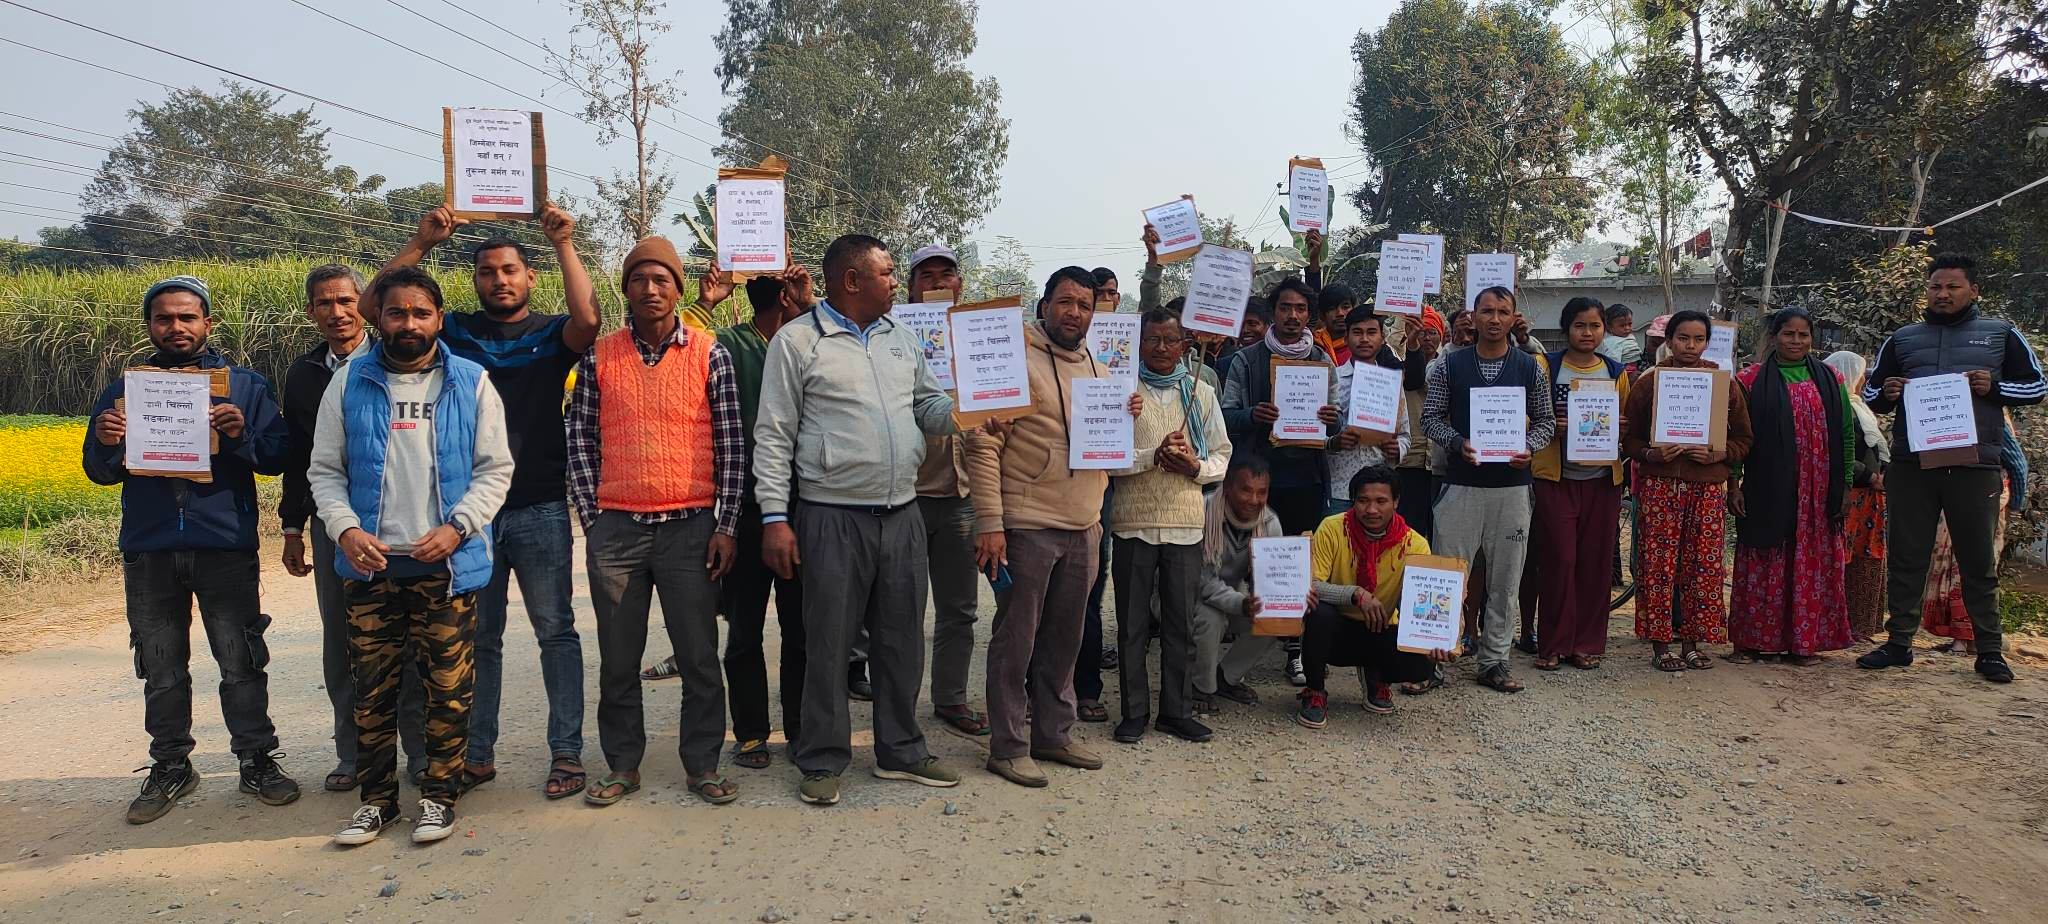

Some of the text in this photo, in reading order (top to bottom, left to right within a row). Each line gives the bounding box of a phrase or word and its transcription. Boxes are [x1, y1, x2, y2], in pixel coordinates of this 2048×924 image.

[470, 138, 519, 148] जिम्मेवार निकाय
[490, 167, 508, 176] मर्मत
[166, 400, 193, 410] चिल्लो
[142, 414, 173, 424] सडकमा
